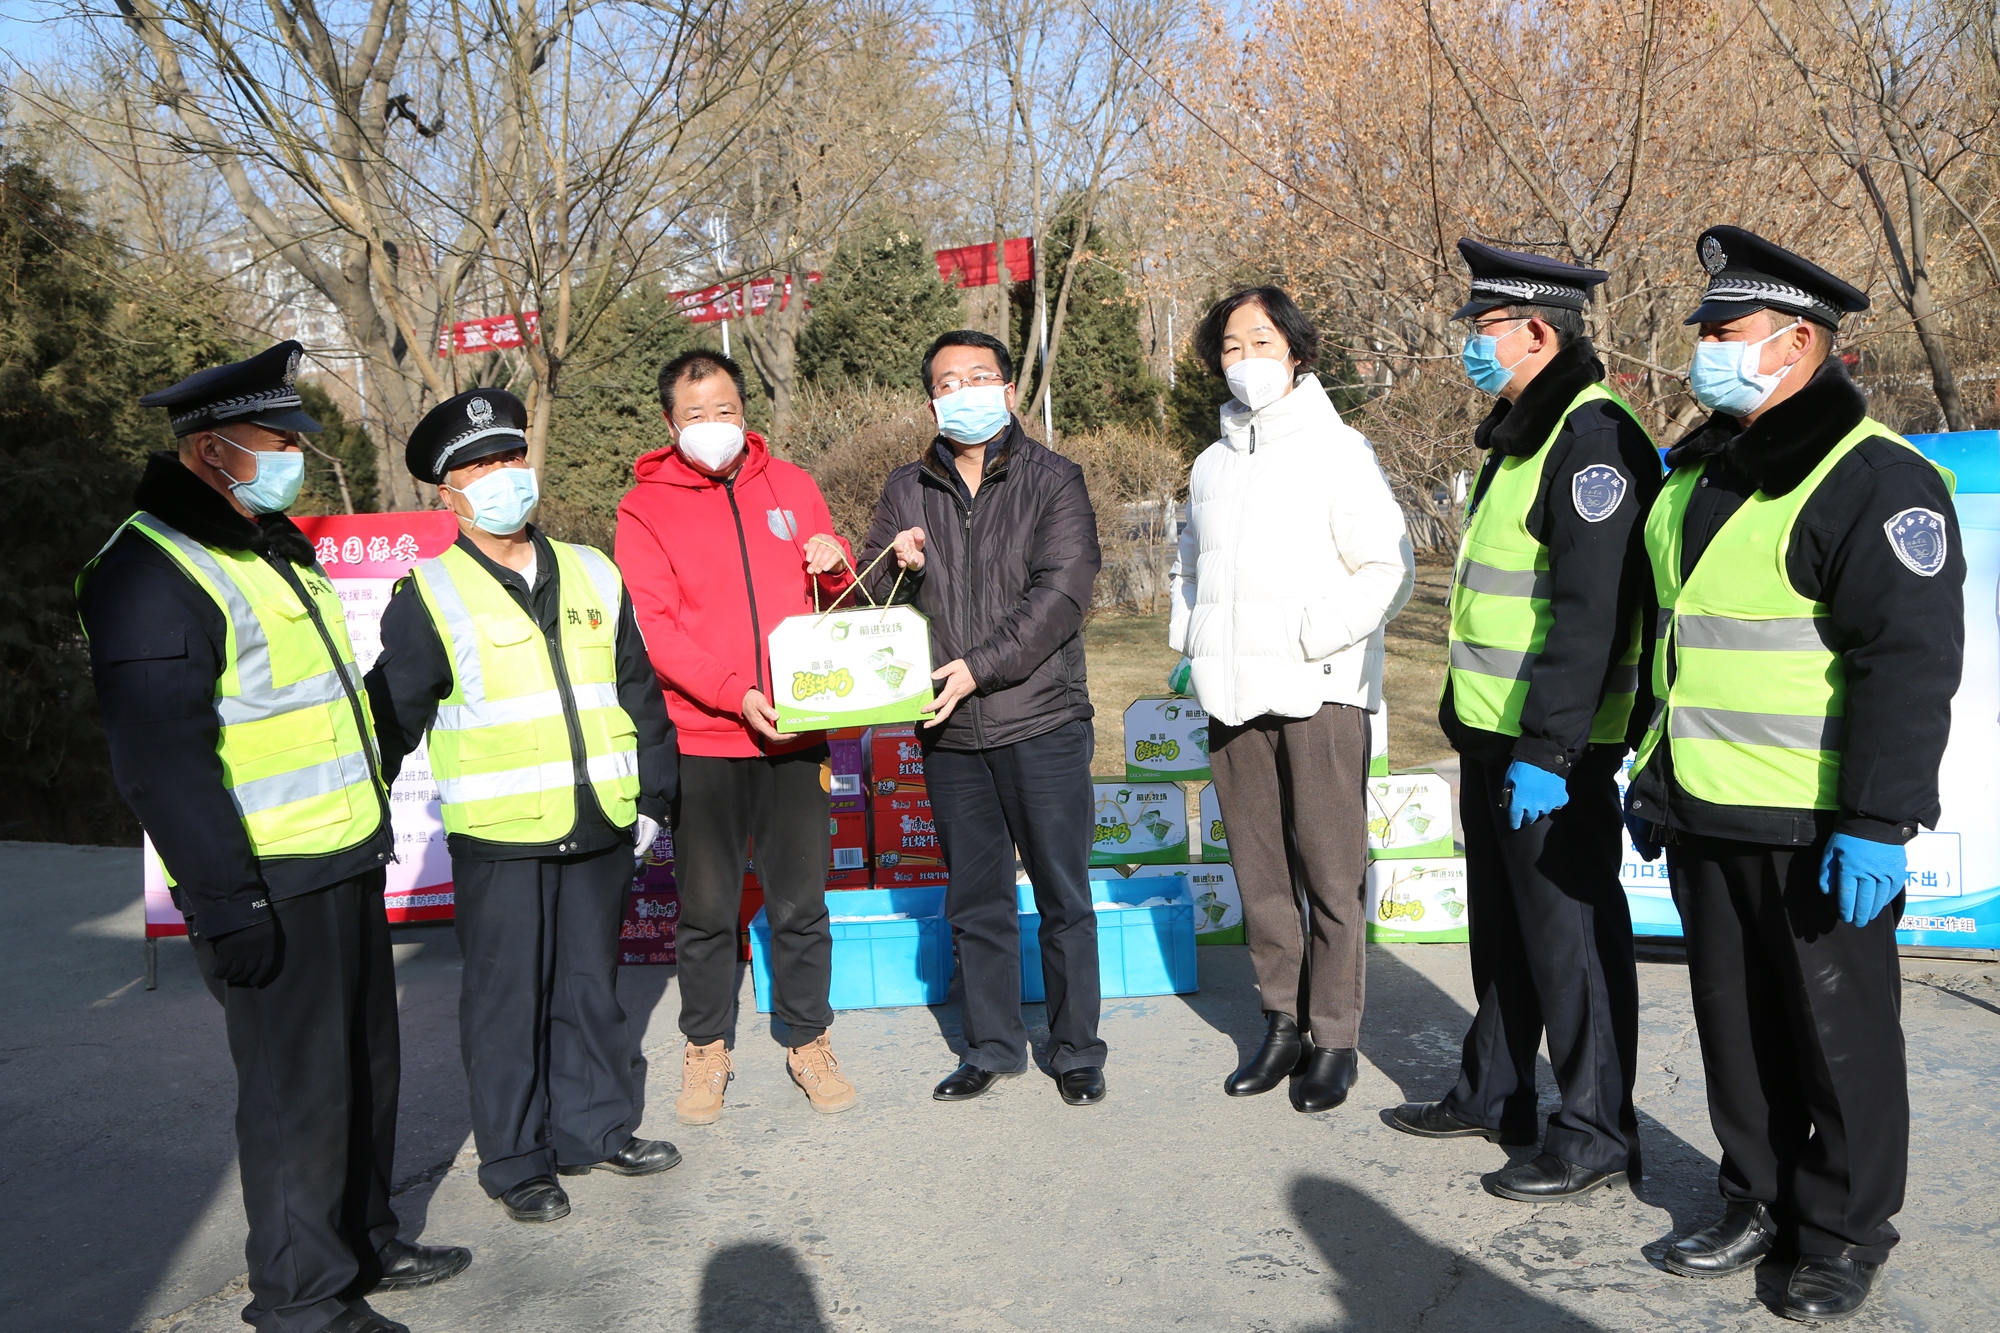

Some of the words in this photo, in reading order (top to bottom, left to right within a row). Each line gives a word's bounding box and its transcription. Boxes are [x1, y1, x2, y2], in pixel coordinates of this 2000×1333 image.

[315, 534, 419, 564] 校园保安
[567, 607, 602, 625] 执勤
[859, 622, 902, 636] 前进牧场
[811, 659, 834, 671] 高品
[792, 668, 855, 701] 酸牛奶
[1135, 739, 1180, 761] 酸牛奶
[899, 762, 924, 775] 红烧
[878, 781, 896, 791] 经典
[1137, 793, 1167, 801] 前进牧场
[651, 839, 674, 850] 老坛
[902, 834, 940, 848] 红烧牛
[656, 850, 674, 859] 牛肉
[881, 853, 898, 863] 经典
[1193, 874, 1223, 883] 前进牧场
[1431, 870, 1463, 878] 前进牧场
[648, 900, 677, 918] 康师傅
[1897, 916, 1975, 932] 保卫工作组
